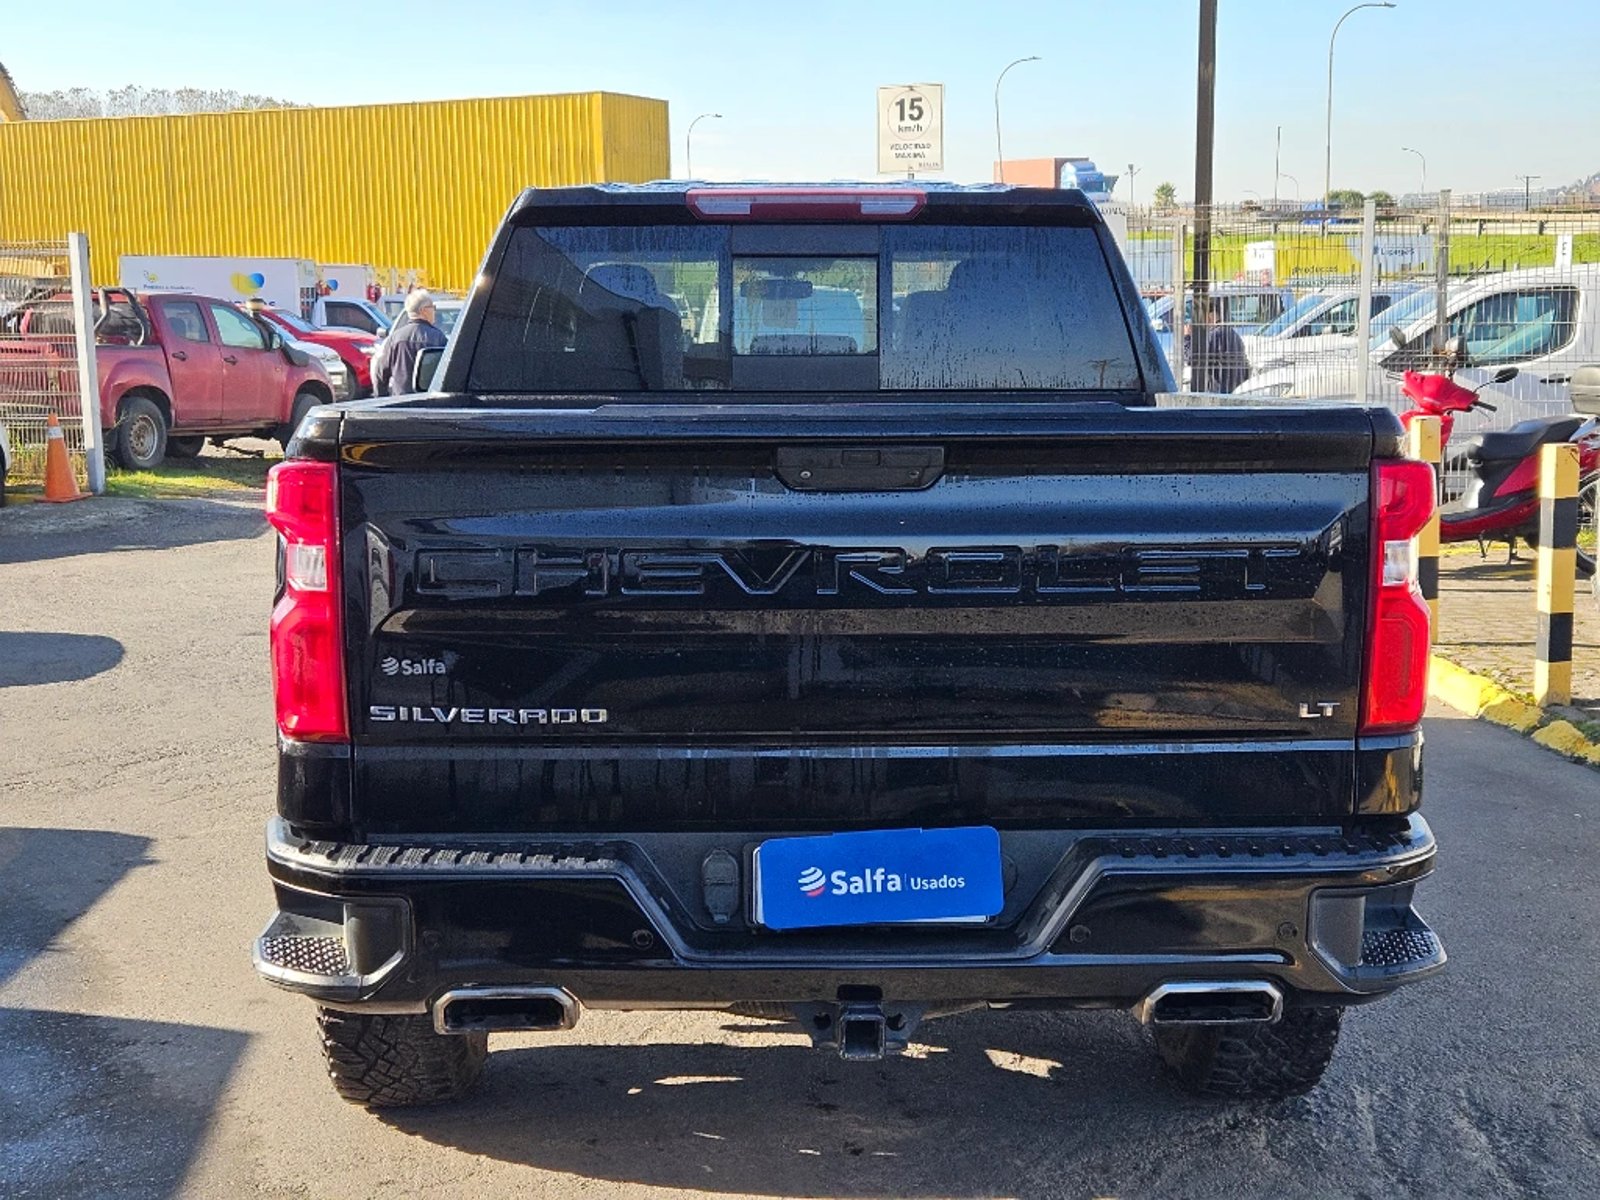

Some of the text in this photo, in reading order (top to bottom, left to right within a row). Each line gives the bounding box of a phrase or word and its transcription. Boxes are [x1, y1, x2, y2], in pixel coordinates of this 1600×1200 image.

[895, 97, 924, 122] 15
[898, 124, 923, 133] km/h
[414, 543, 1302, 596] CHEVROLET
[401, 658, 447, 676] Salfa
[369, 705, 608, 725] SILVERADO
[1298, 702, 1341, 718] LT
[830, 867, 966, 896] Salfa Usados
